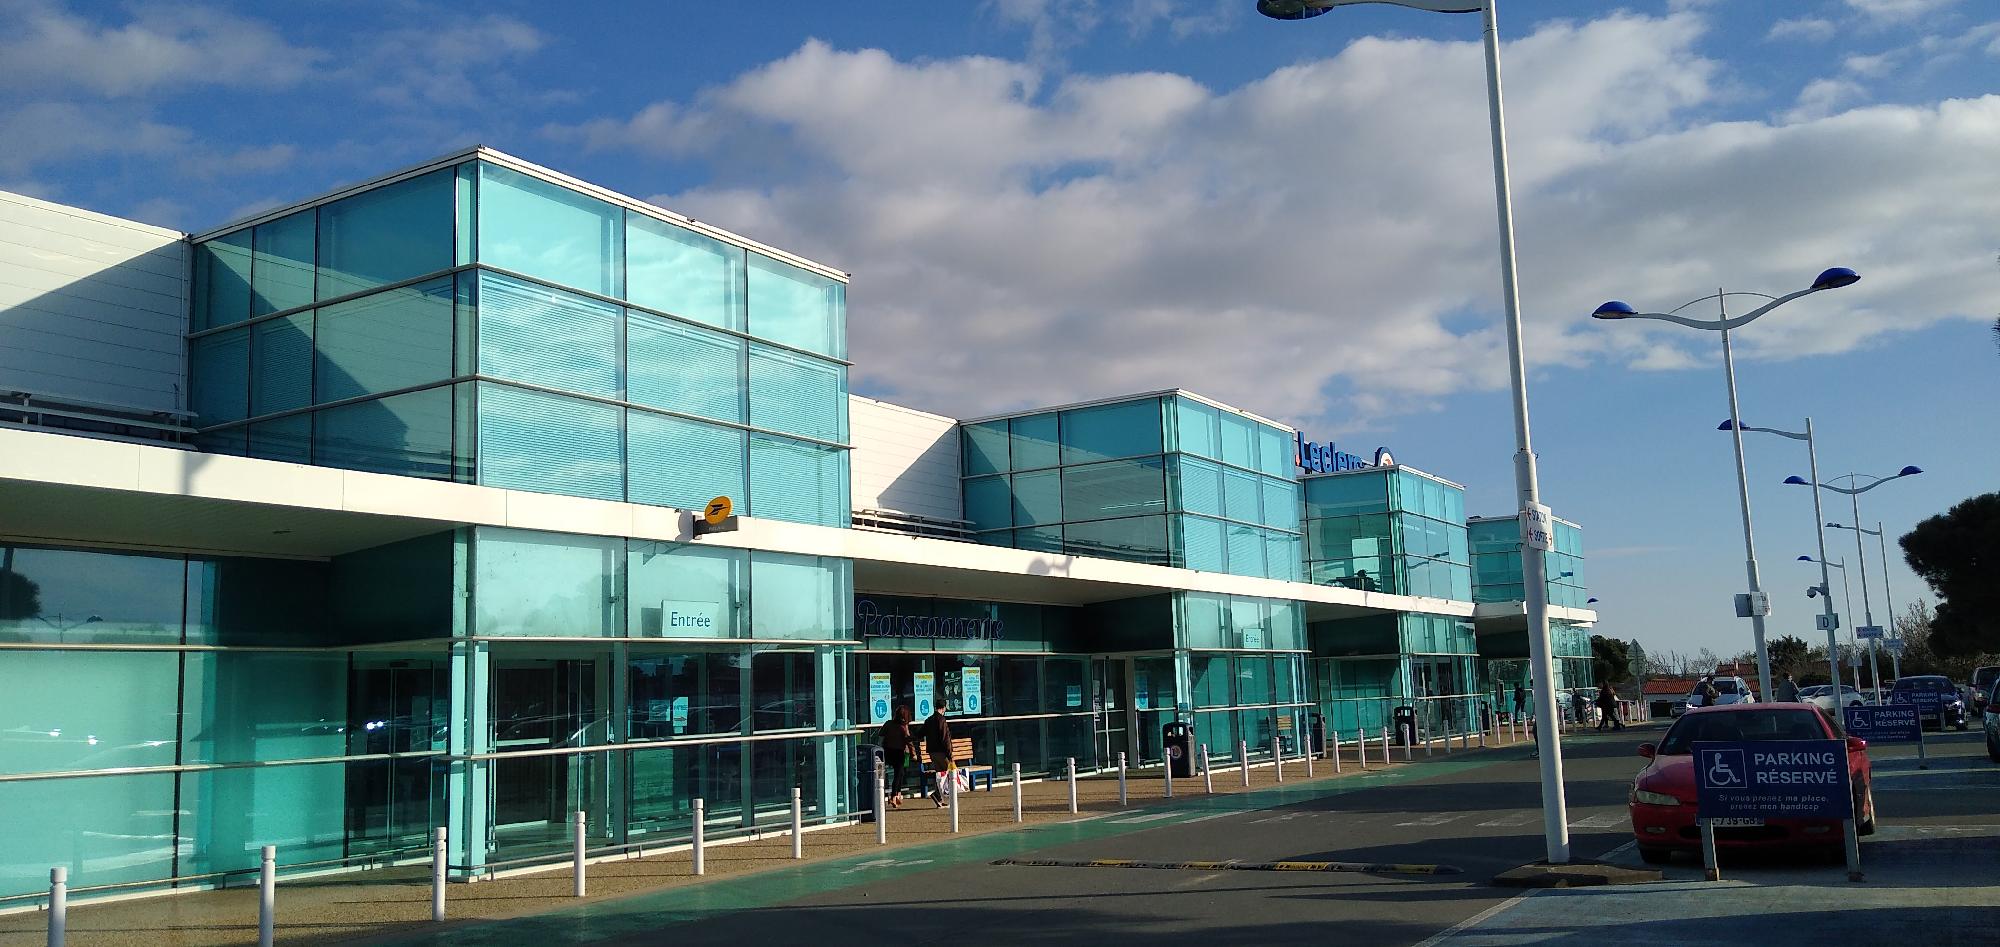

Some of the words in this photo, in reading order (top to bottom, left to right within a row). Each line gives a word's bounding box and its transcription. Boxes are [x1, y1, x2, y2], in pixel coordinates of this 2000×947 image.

[671, 612, 711, 628] Entrée
[857, 600, 1004, 639] Poissonnerie
[1823, 617, 1829, 627] D
[1874, 710, 1915, 718] PARKING
[1875, 718, 1916, 727] RÉSERVÉ
[1754, 752, 1835, 765] PARKING
[1756, 769, 1838, 784] RÉSERVÉ
[1780, 803, 1820, 812] handicap
